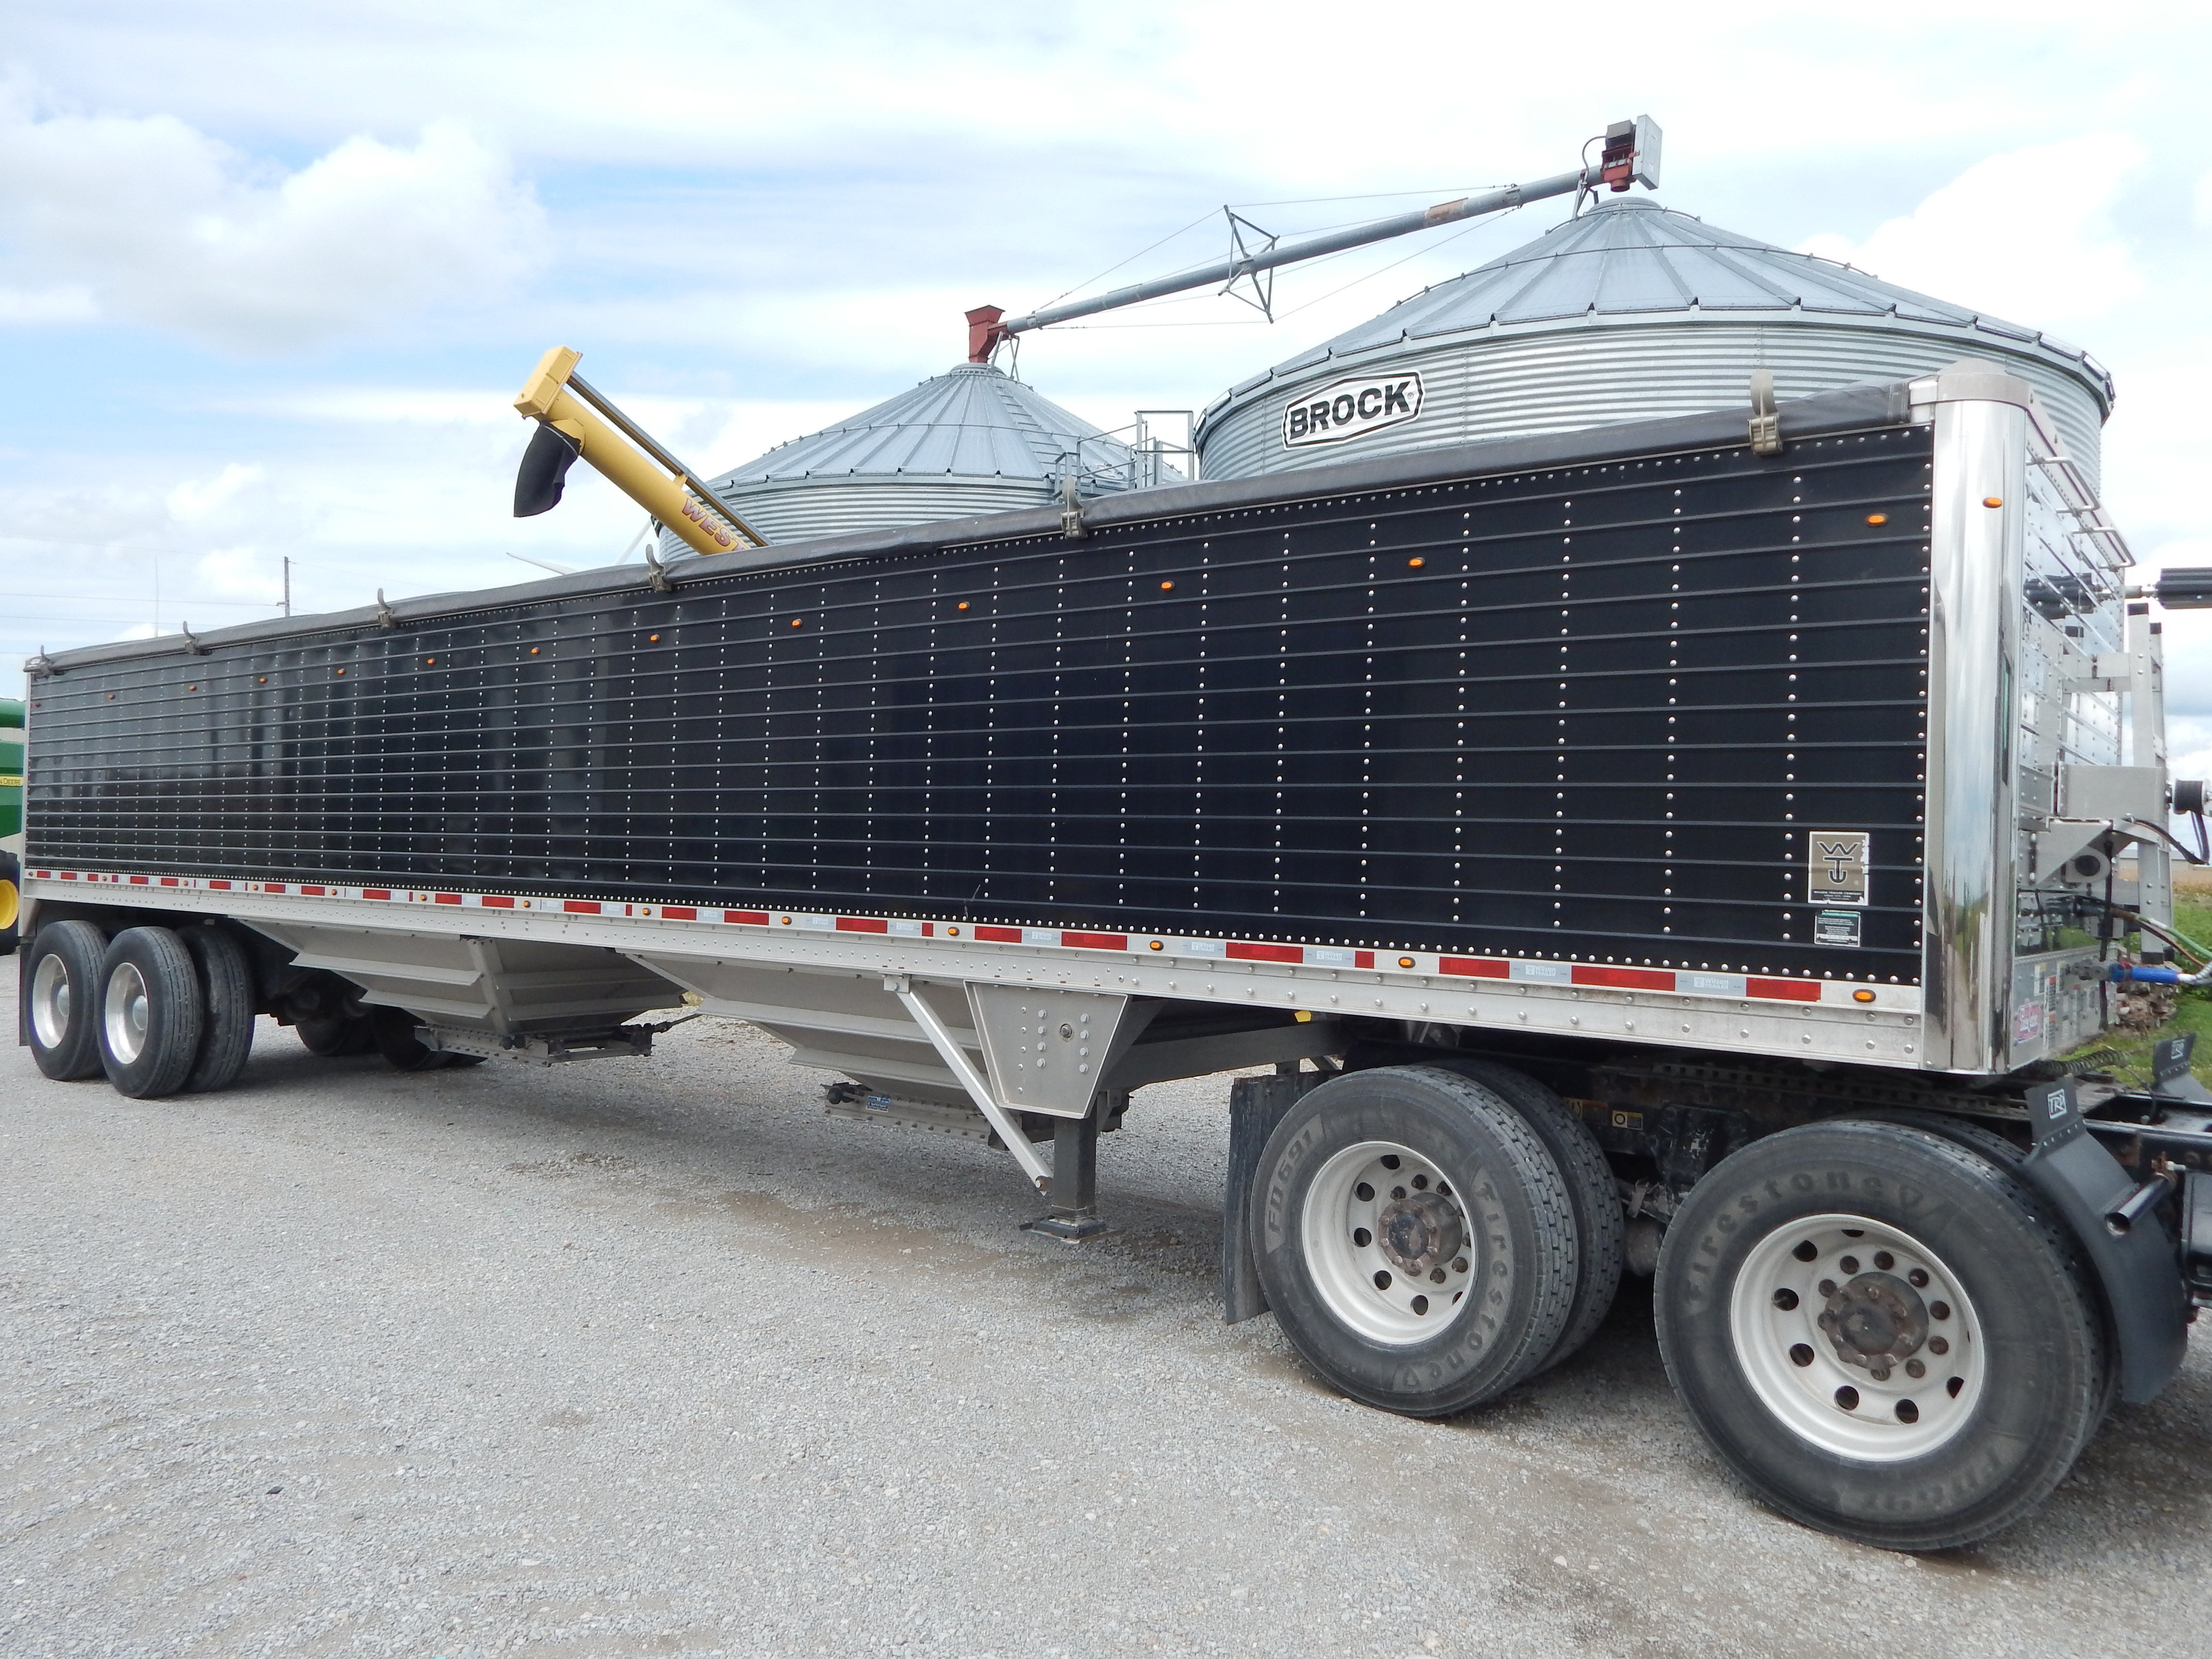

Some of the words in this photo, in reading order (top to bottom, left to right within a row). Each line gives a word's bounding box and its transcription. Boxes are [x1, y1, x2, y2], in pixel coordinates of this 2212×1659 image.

[1290, 381, 1411, 440] BROCK
[1429, 1181, 1508, 1379] Firestone
[1686, 1171, 1882, 1302] Firestone
